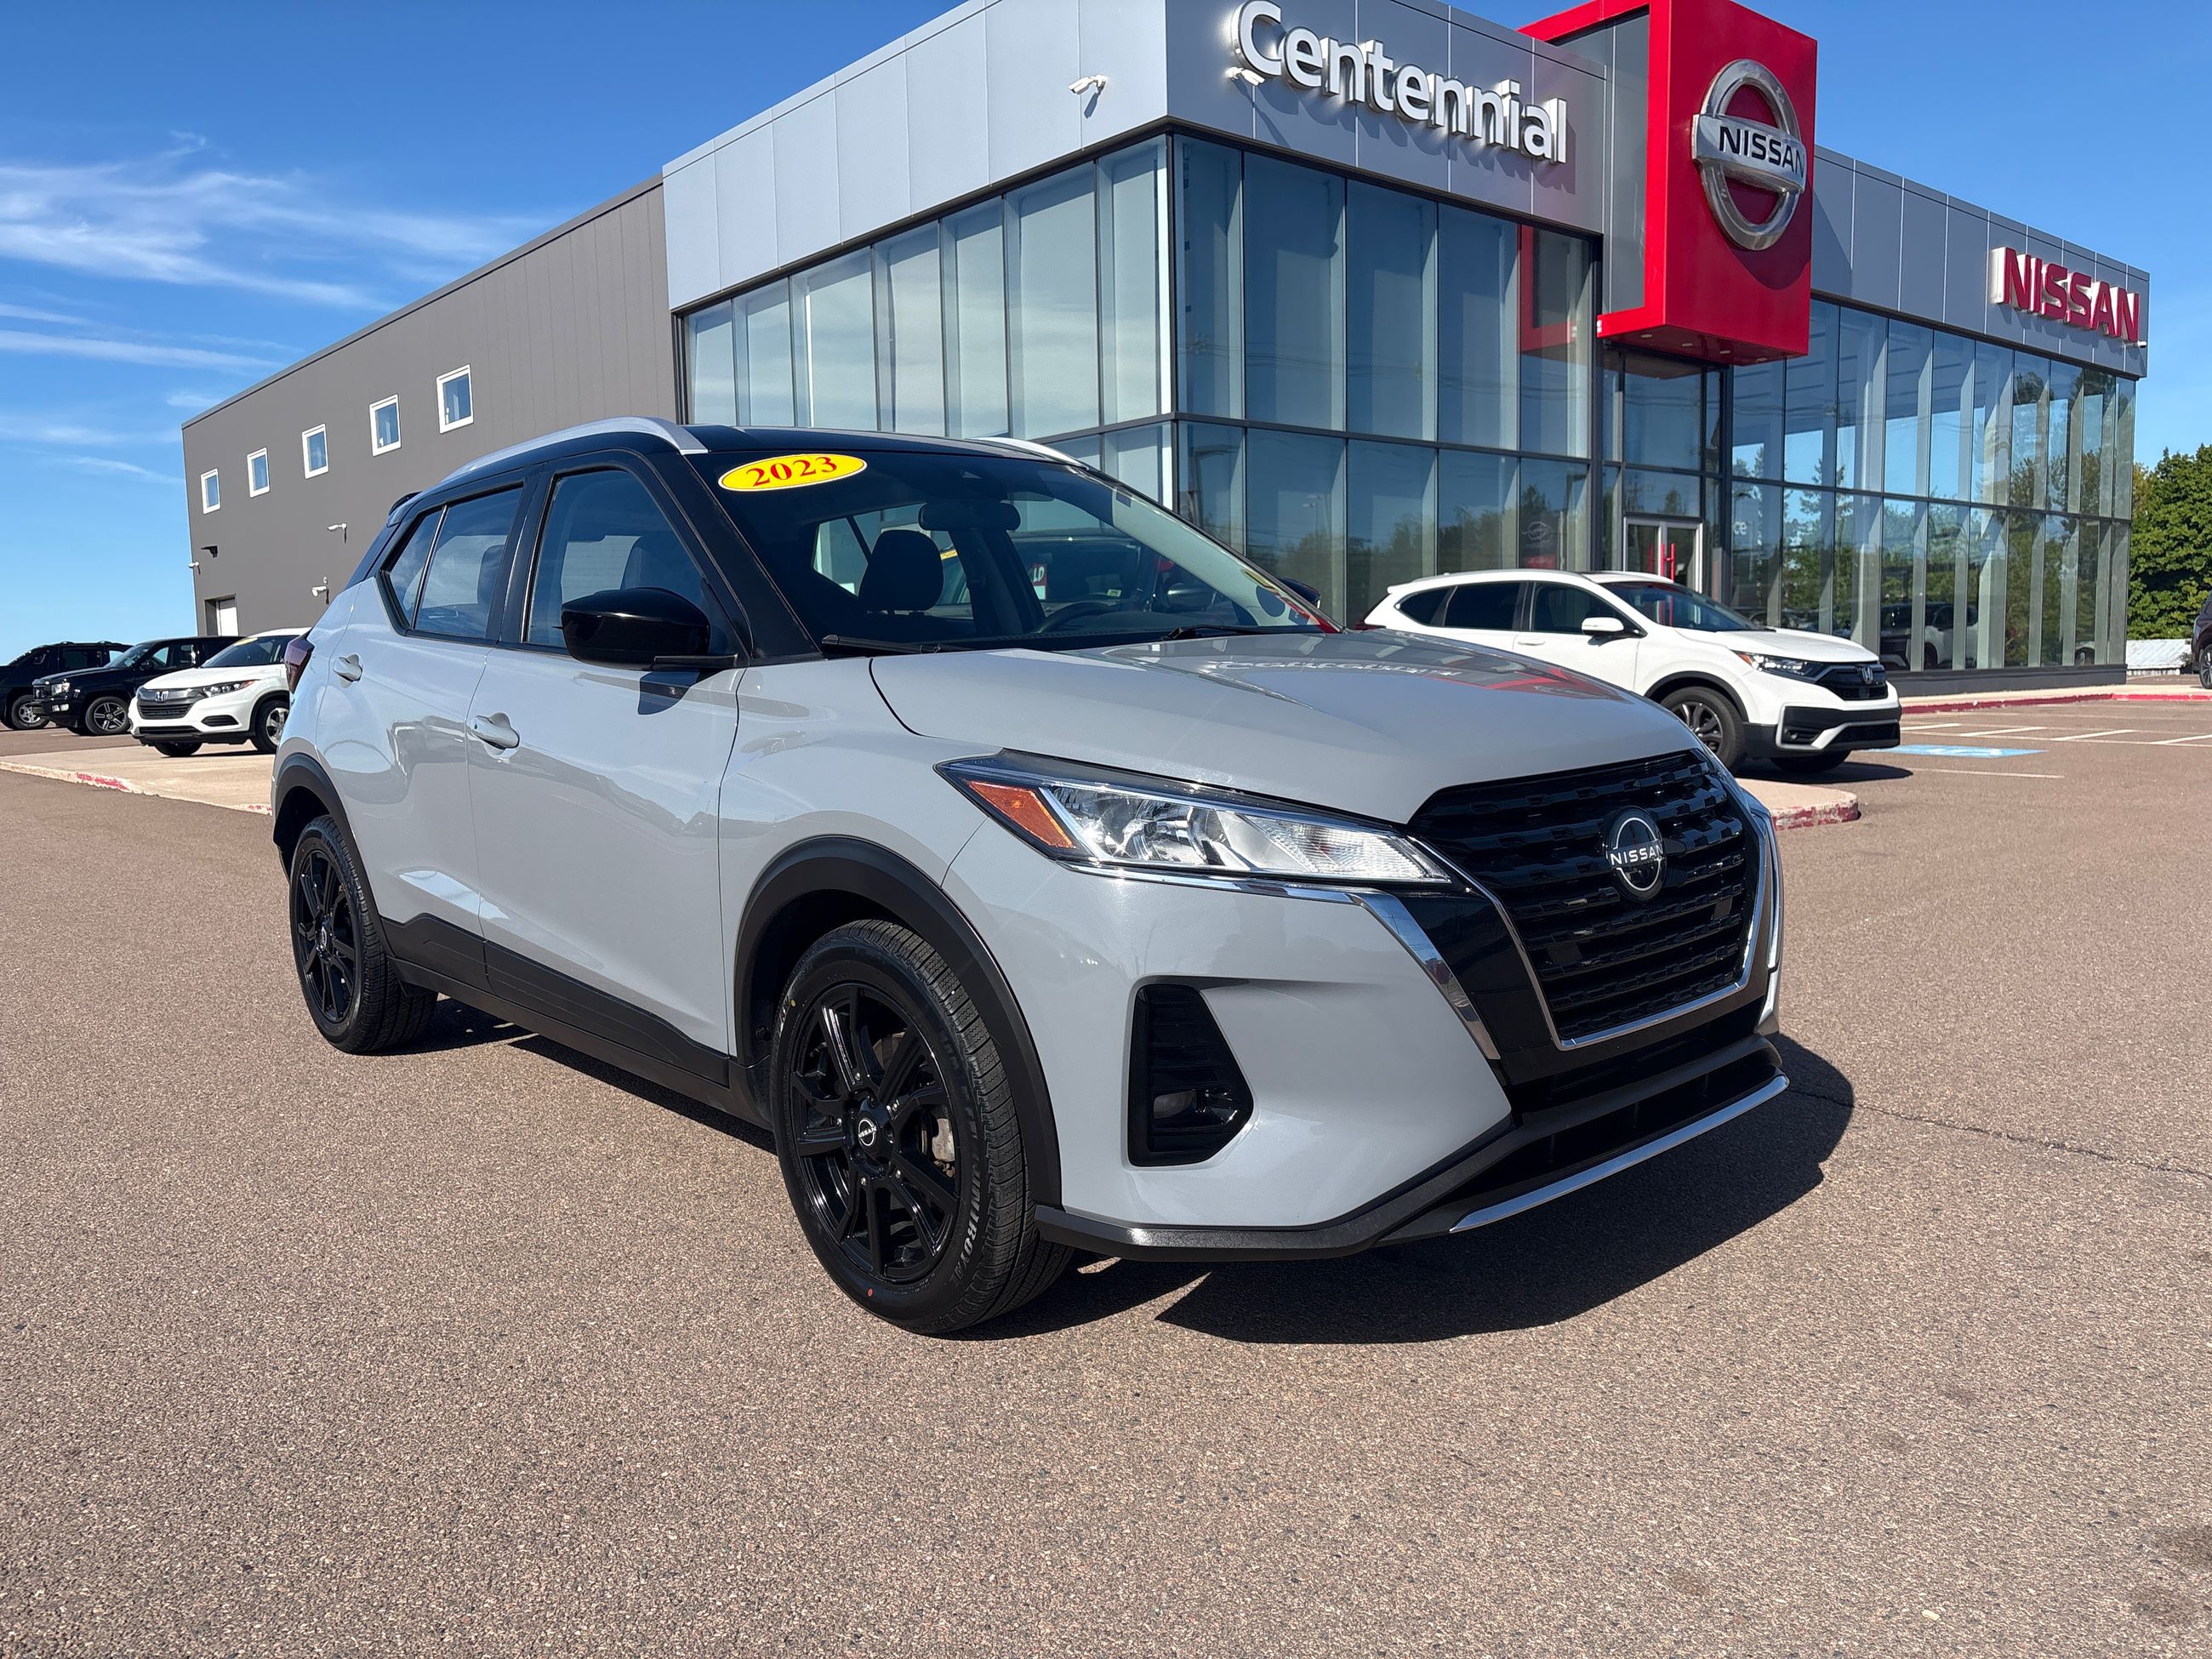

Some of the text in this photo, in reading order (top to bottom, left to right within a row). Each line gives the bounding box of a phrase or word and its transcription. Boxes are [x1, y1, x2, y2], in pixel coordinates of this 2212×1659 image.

[1234, 0, 1567, 164] Centennial
[1719, 126, 1804, 178] NISSAN
[1998, 247, 2140, 343] NISSAN
[746, 456, 837, 487] 2023
[1610, 844, 1663, 865] NISSAN
